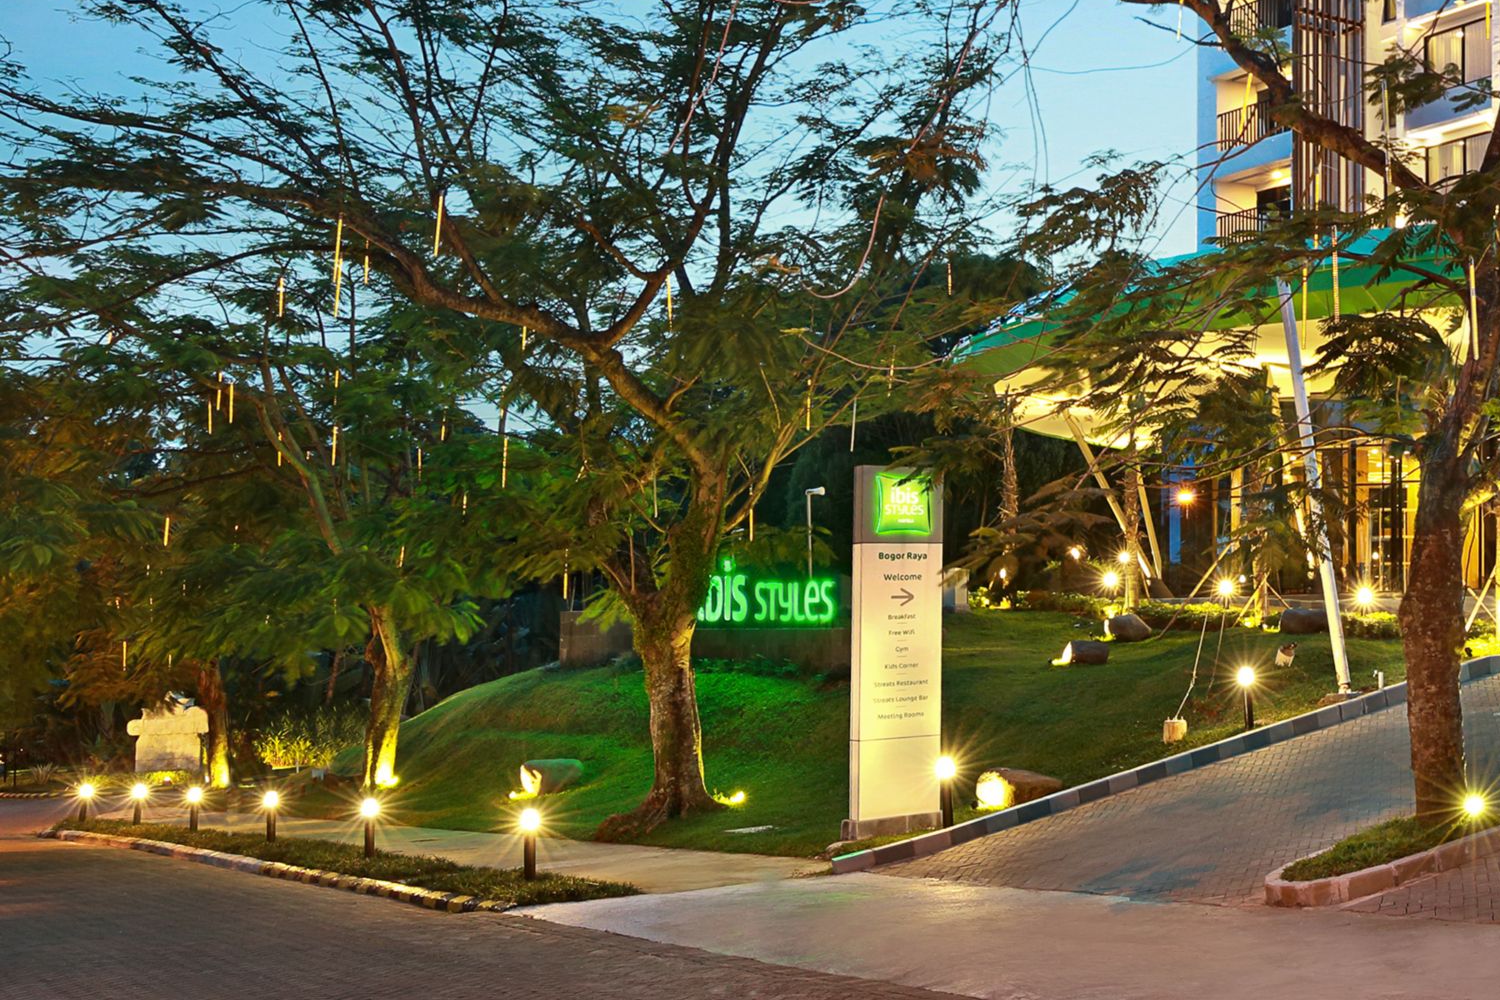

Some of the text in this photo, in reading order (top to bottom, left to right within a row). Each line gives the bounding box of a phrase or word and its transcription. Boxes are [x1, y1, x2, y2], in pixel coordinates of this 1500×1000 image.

[890, 487, 919, 504] ibis
[878, 552, 928, 561] Bogor Raya
[883, 573, 922, 581] Welcome
[697, 560, 748, 622] bis
